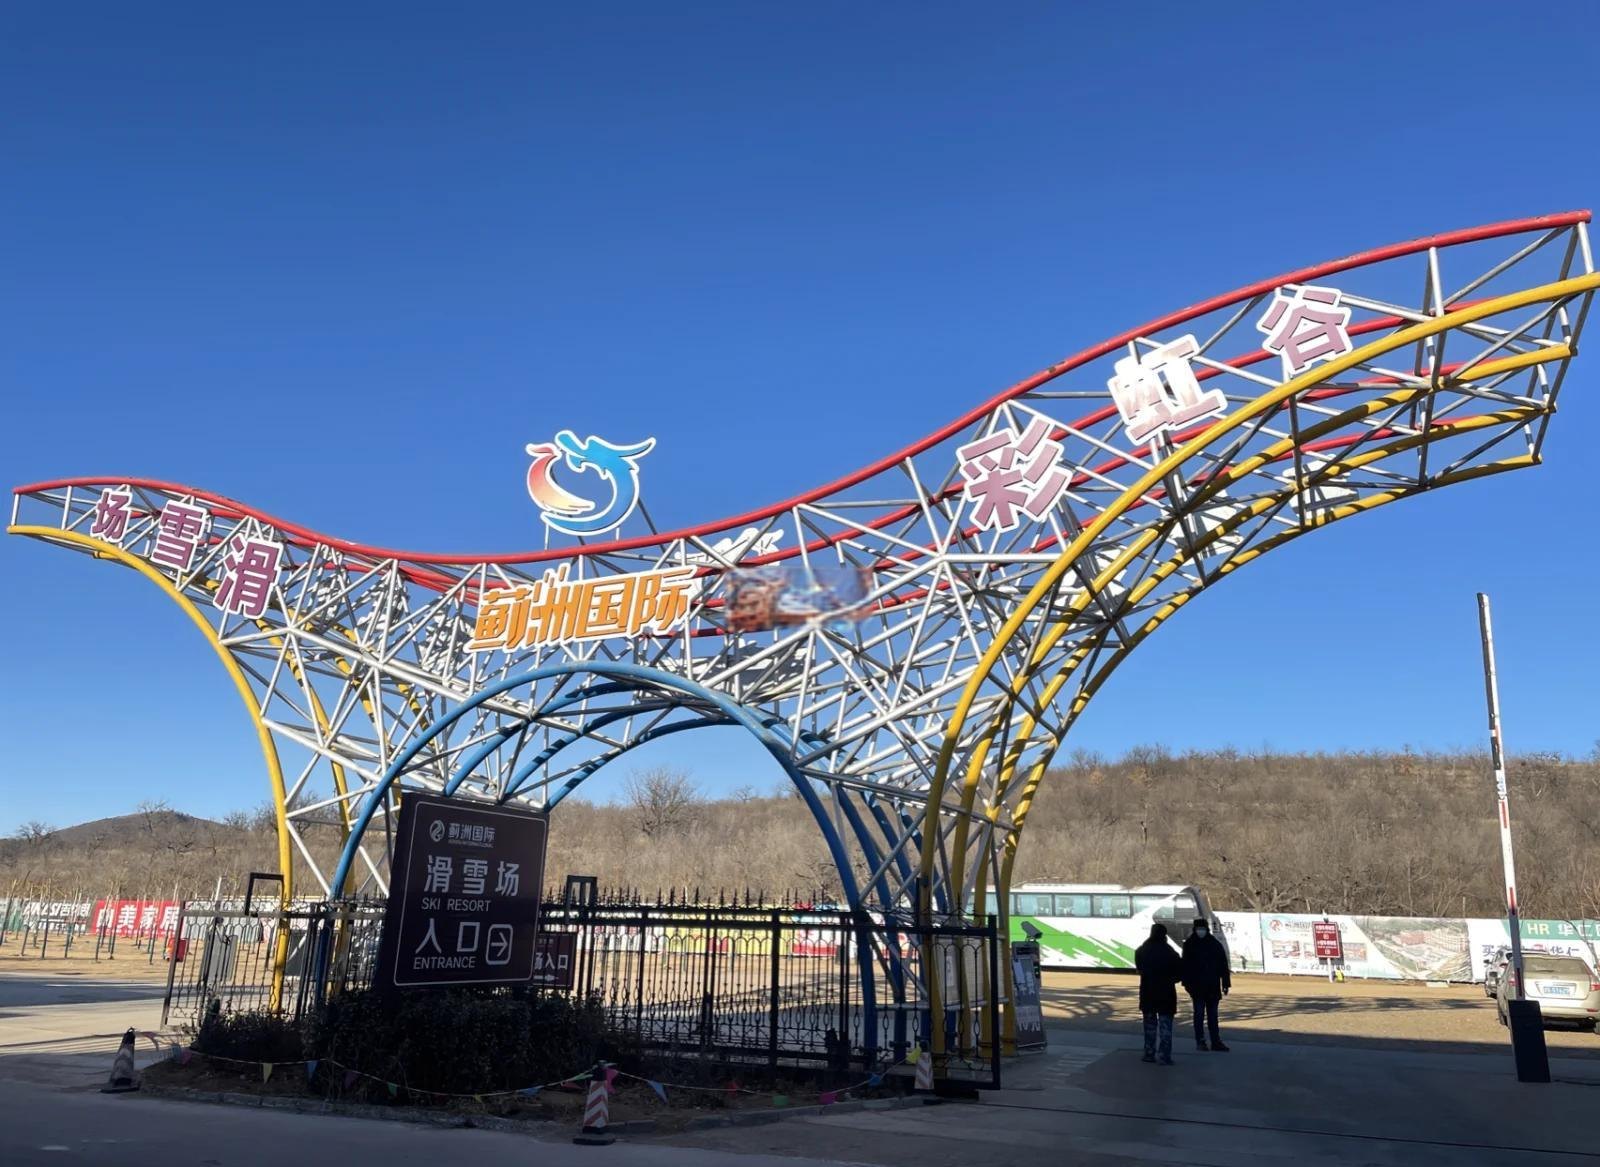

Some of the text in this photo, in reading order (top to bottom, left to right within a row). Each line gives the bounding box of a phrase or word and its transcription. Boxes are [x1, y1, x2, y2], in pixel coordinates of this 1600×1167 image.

[464, 564, 699, 653] 蓟洲国际
[424, 855, 520, 896] 滑雪场
[421, 897, 492, 912] SKI RESORT
[1527, 923, 1550, 935] HR
[413, 956, 476, 969] ENTRANCE
